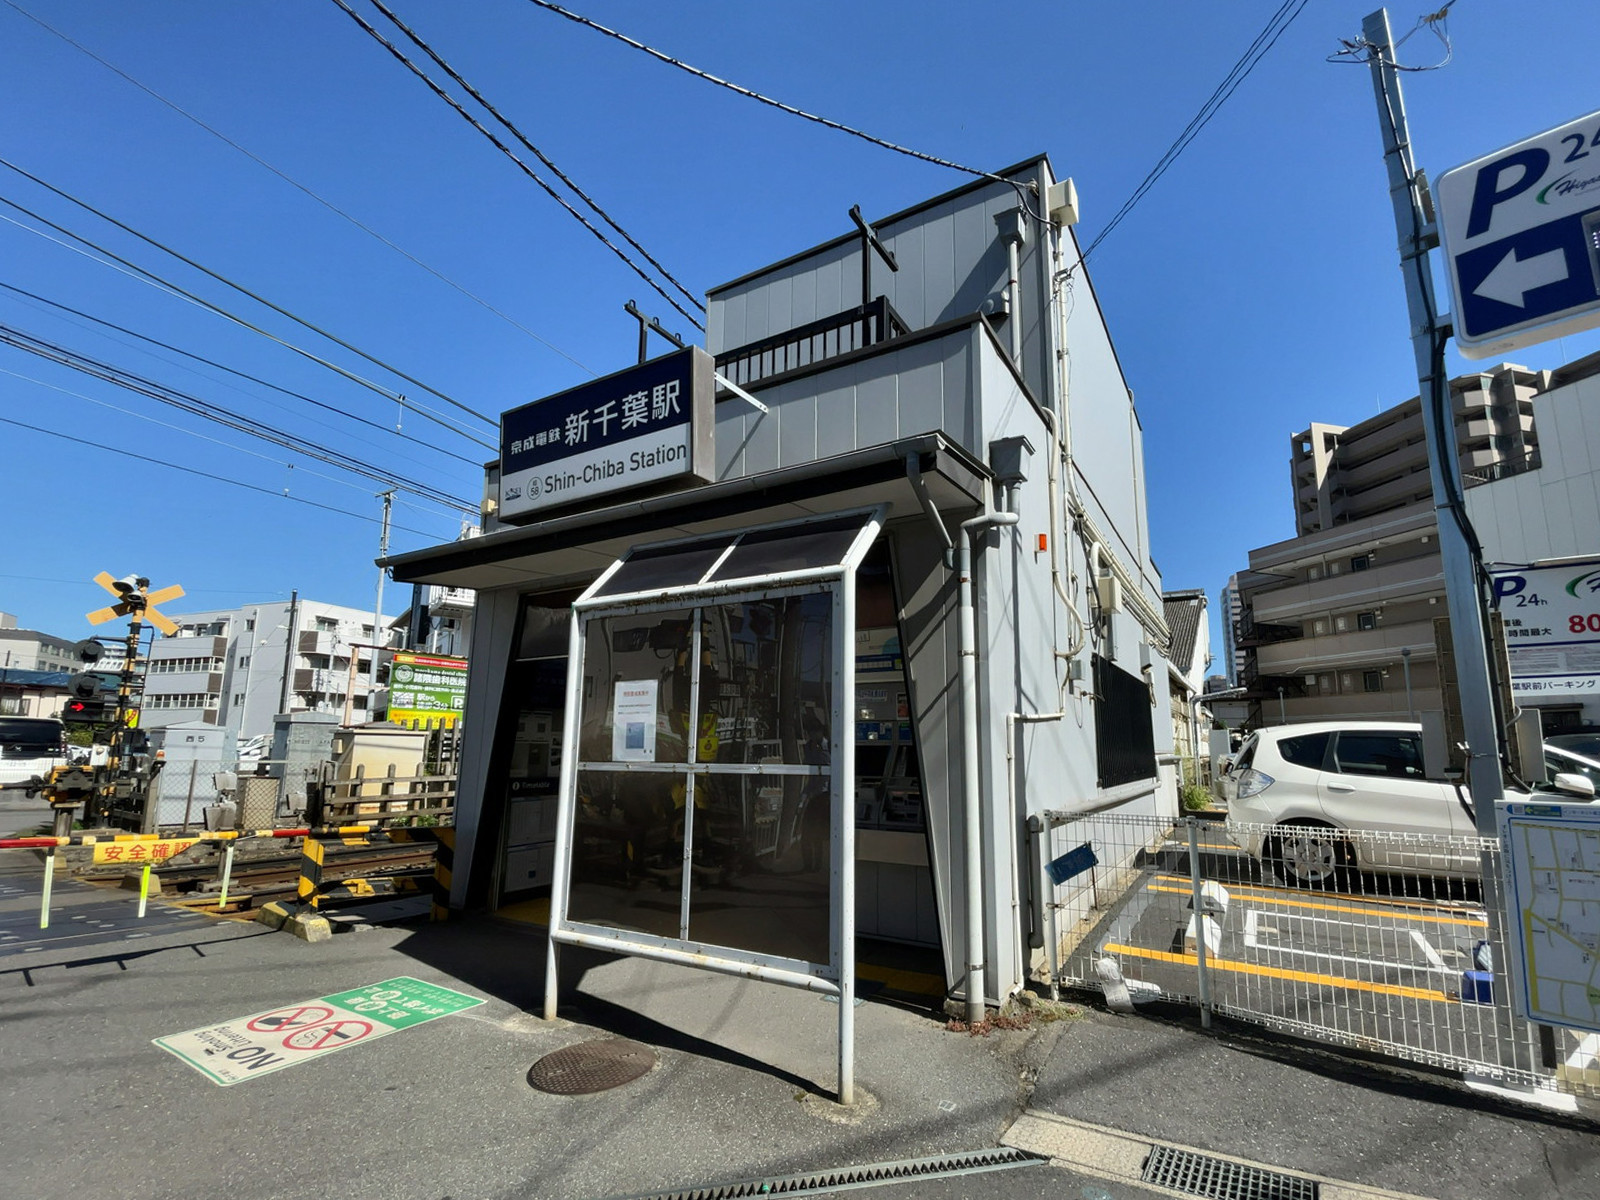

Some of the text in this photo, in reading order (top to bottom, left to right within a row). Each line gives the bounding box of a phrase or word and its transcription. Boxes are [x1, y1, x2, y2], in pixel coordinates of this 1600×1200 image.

[1466, 147, 1550, 240] P
[510, 379, 681, 455] 京成電鉄 新千葉駅
[544, 443, 687, 494] Shin-Chiba Station
[530, 486, 540, 497] 58
[1515, 593, 1548, 608] 24h
[194, 1031, 233, 1053] Smoking
[226, 1046, 285, 1070] NO
